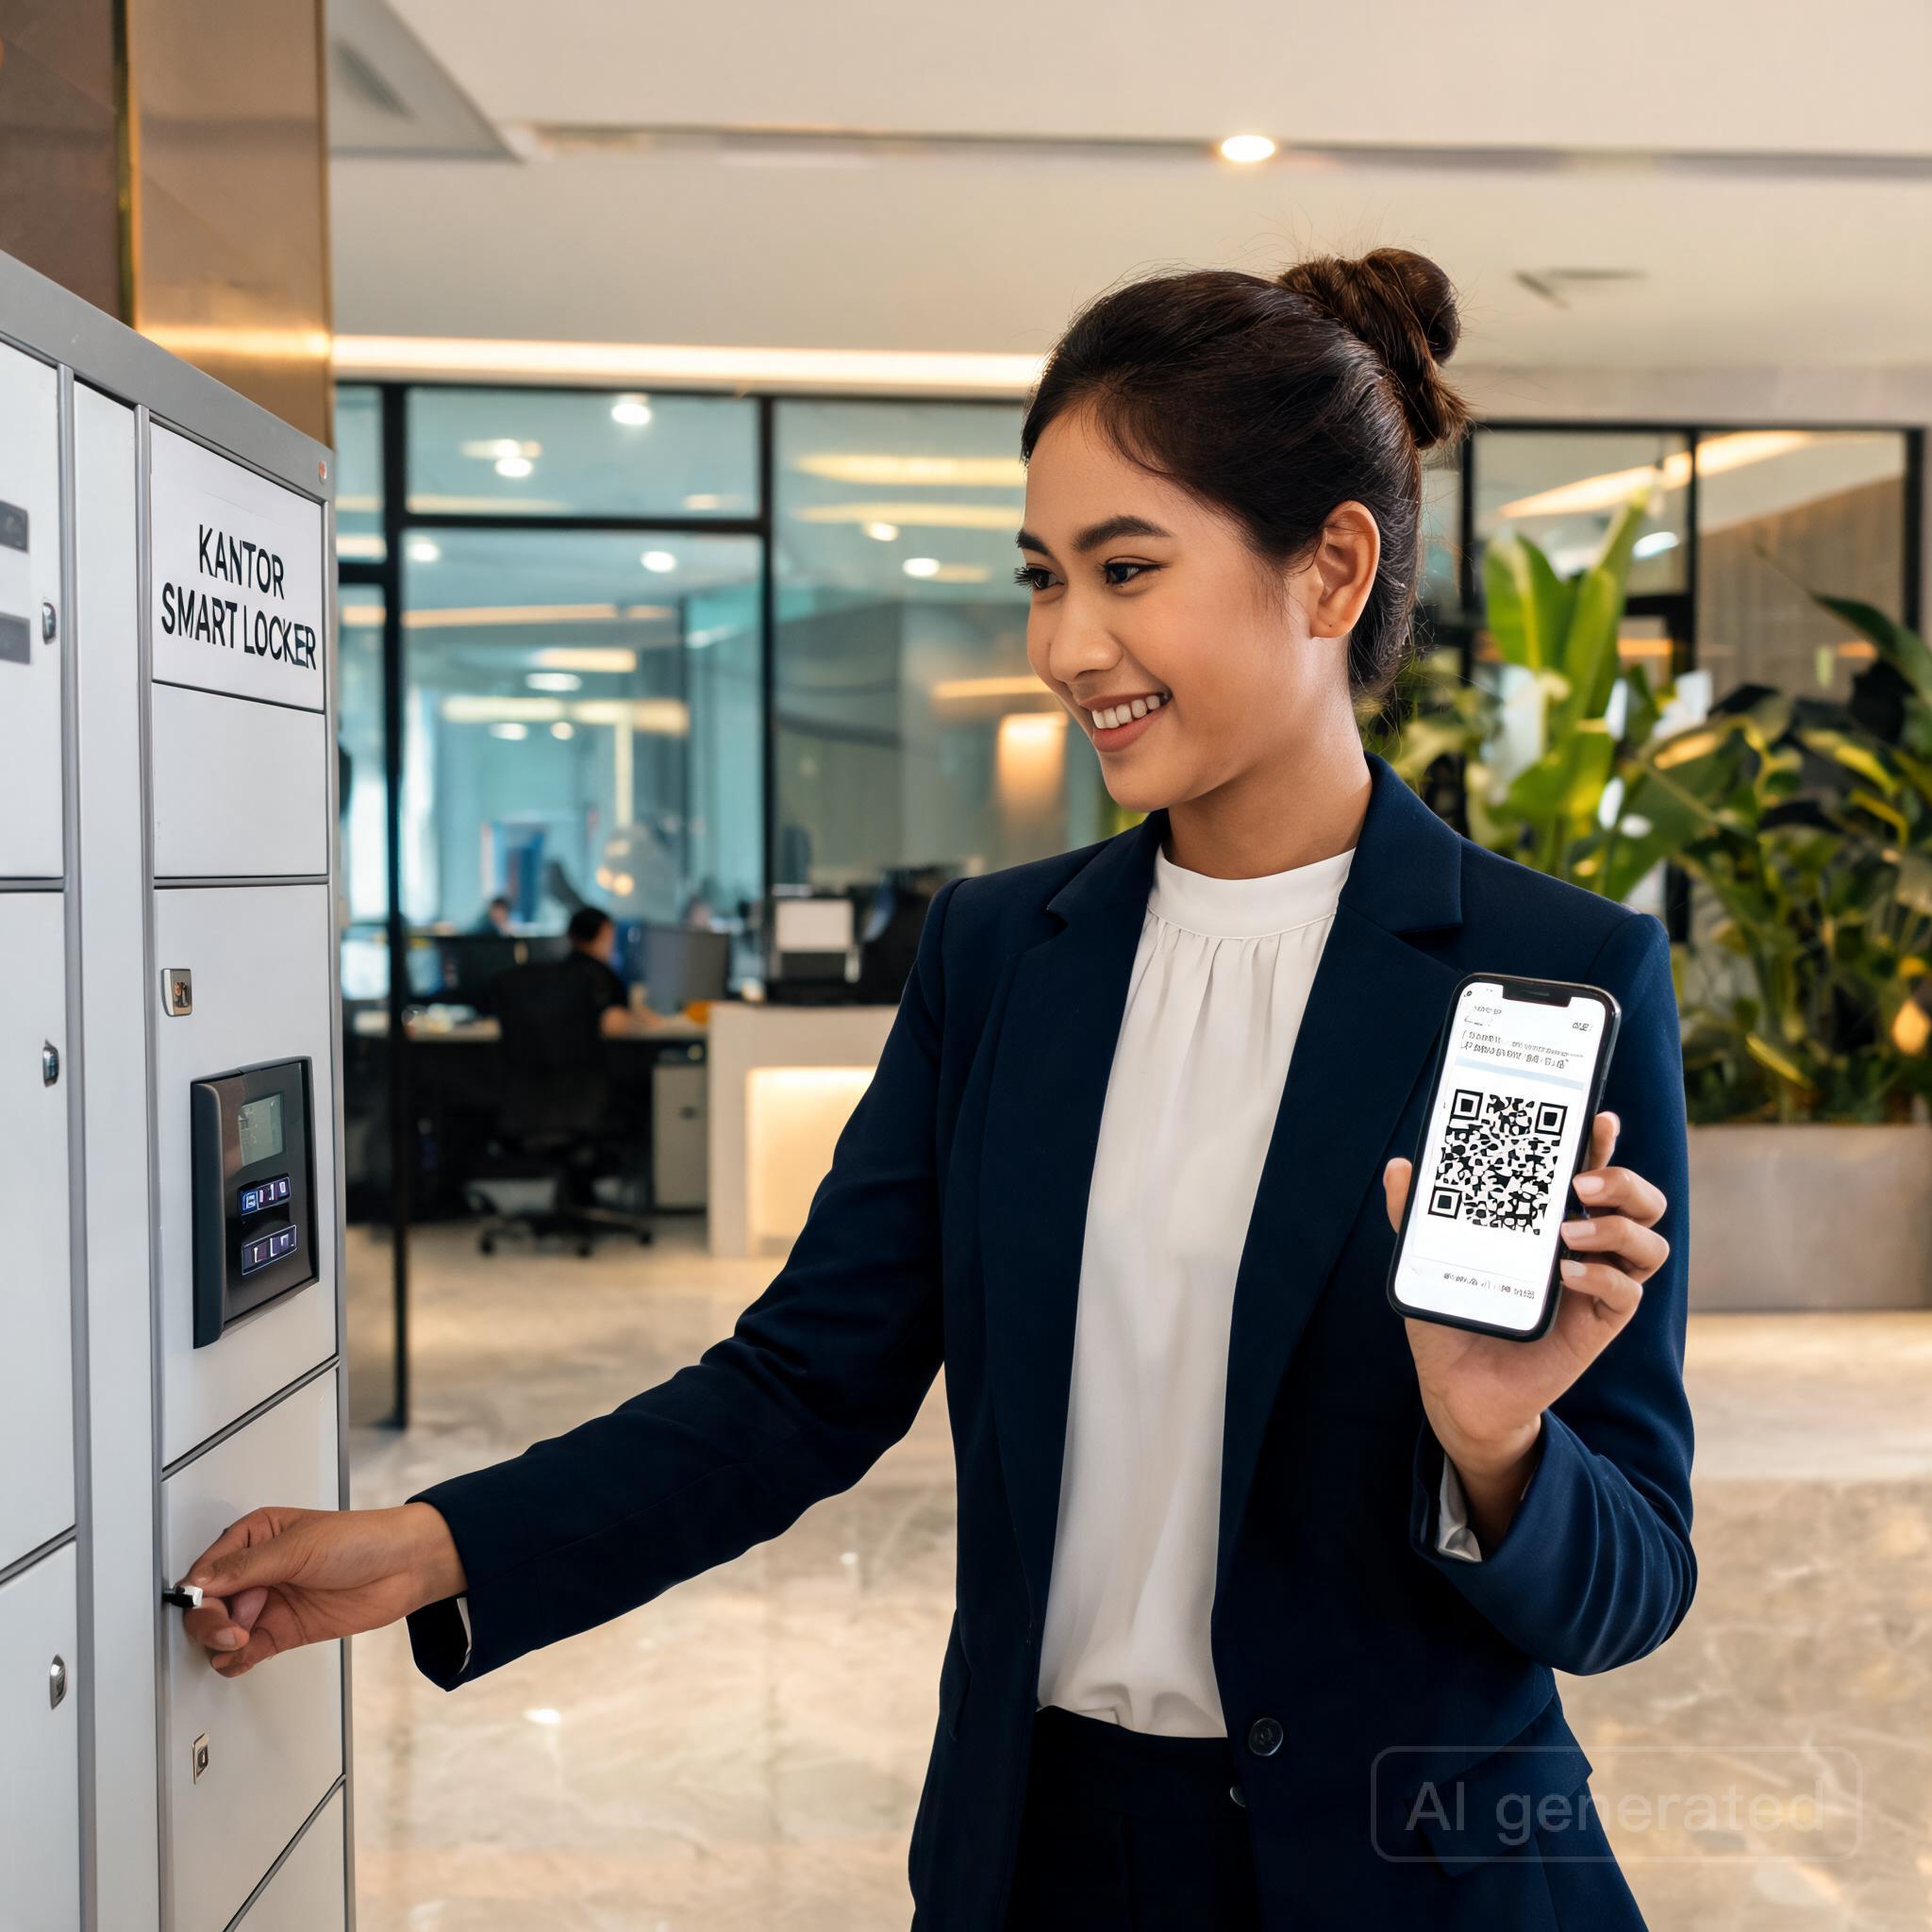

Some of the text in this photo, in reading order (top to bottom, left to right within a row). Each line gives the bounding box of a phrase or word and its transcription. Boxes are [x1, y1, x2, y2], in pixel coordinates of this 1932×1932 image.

[199, 525, 285, 600] KANTOR
[161, 582, 317, 671] SMART LOCKER
